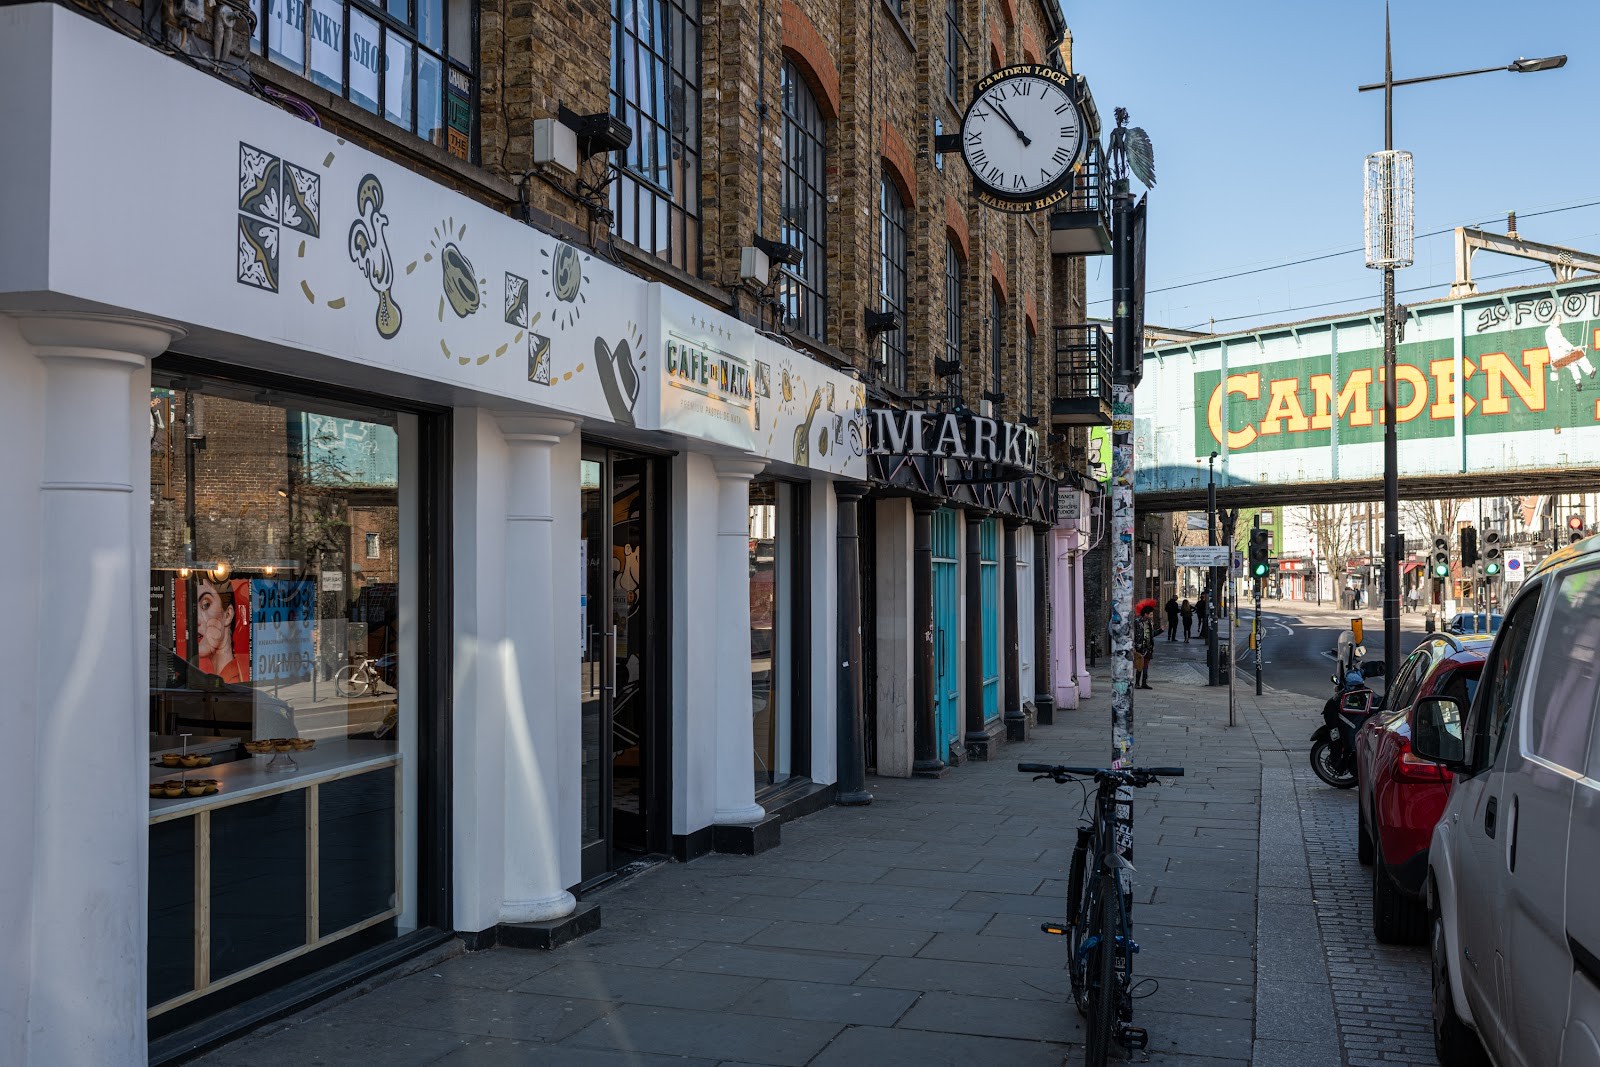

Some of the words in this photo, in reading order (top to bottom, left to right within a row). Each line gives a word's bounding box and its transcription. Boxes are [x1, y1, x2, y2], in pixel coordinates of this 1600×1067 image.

[978, 65, 1032, 91] CAMDEN
[1034, 66, 1070, 87] LOCK
[989, 87, 1007, 106] XI
[1011, 82, 1031, 97] XII
[1040, 87, 1049, 100] I
[973, 108, 989, 122] X
[1054, 103, 1069, 115] II
[968, 131, 982, 146] IX
[1060, 126, 1074, 138] III
[970, 149, 989, 173] VIII
[1052, 147, 1071, 166] IIII
[987, 167, 1005, 186] VII
[1013, 174, 1028, 188] VI
[1040, 168, 1052, 182] V
[978, 191, 1032, 212] MARKET
[1035, 188, 1069, 210] HALL
[665, 340, 708, 387] CAFE
[718, 359, 752, 401] NATA
[1207, 347, 1551, 450] CAMDEN
